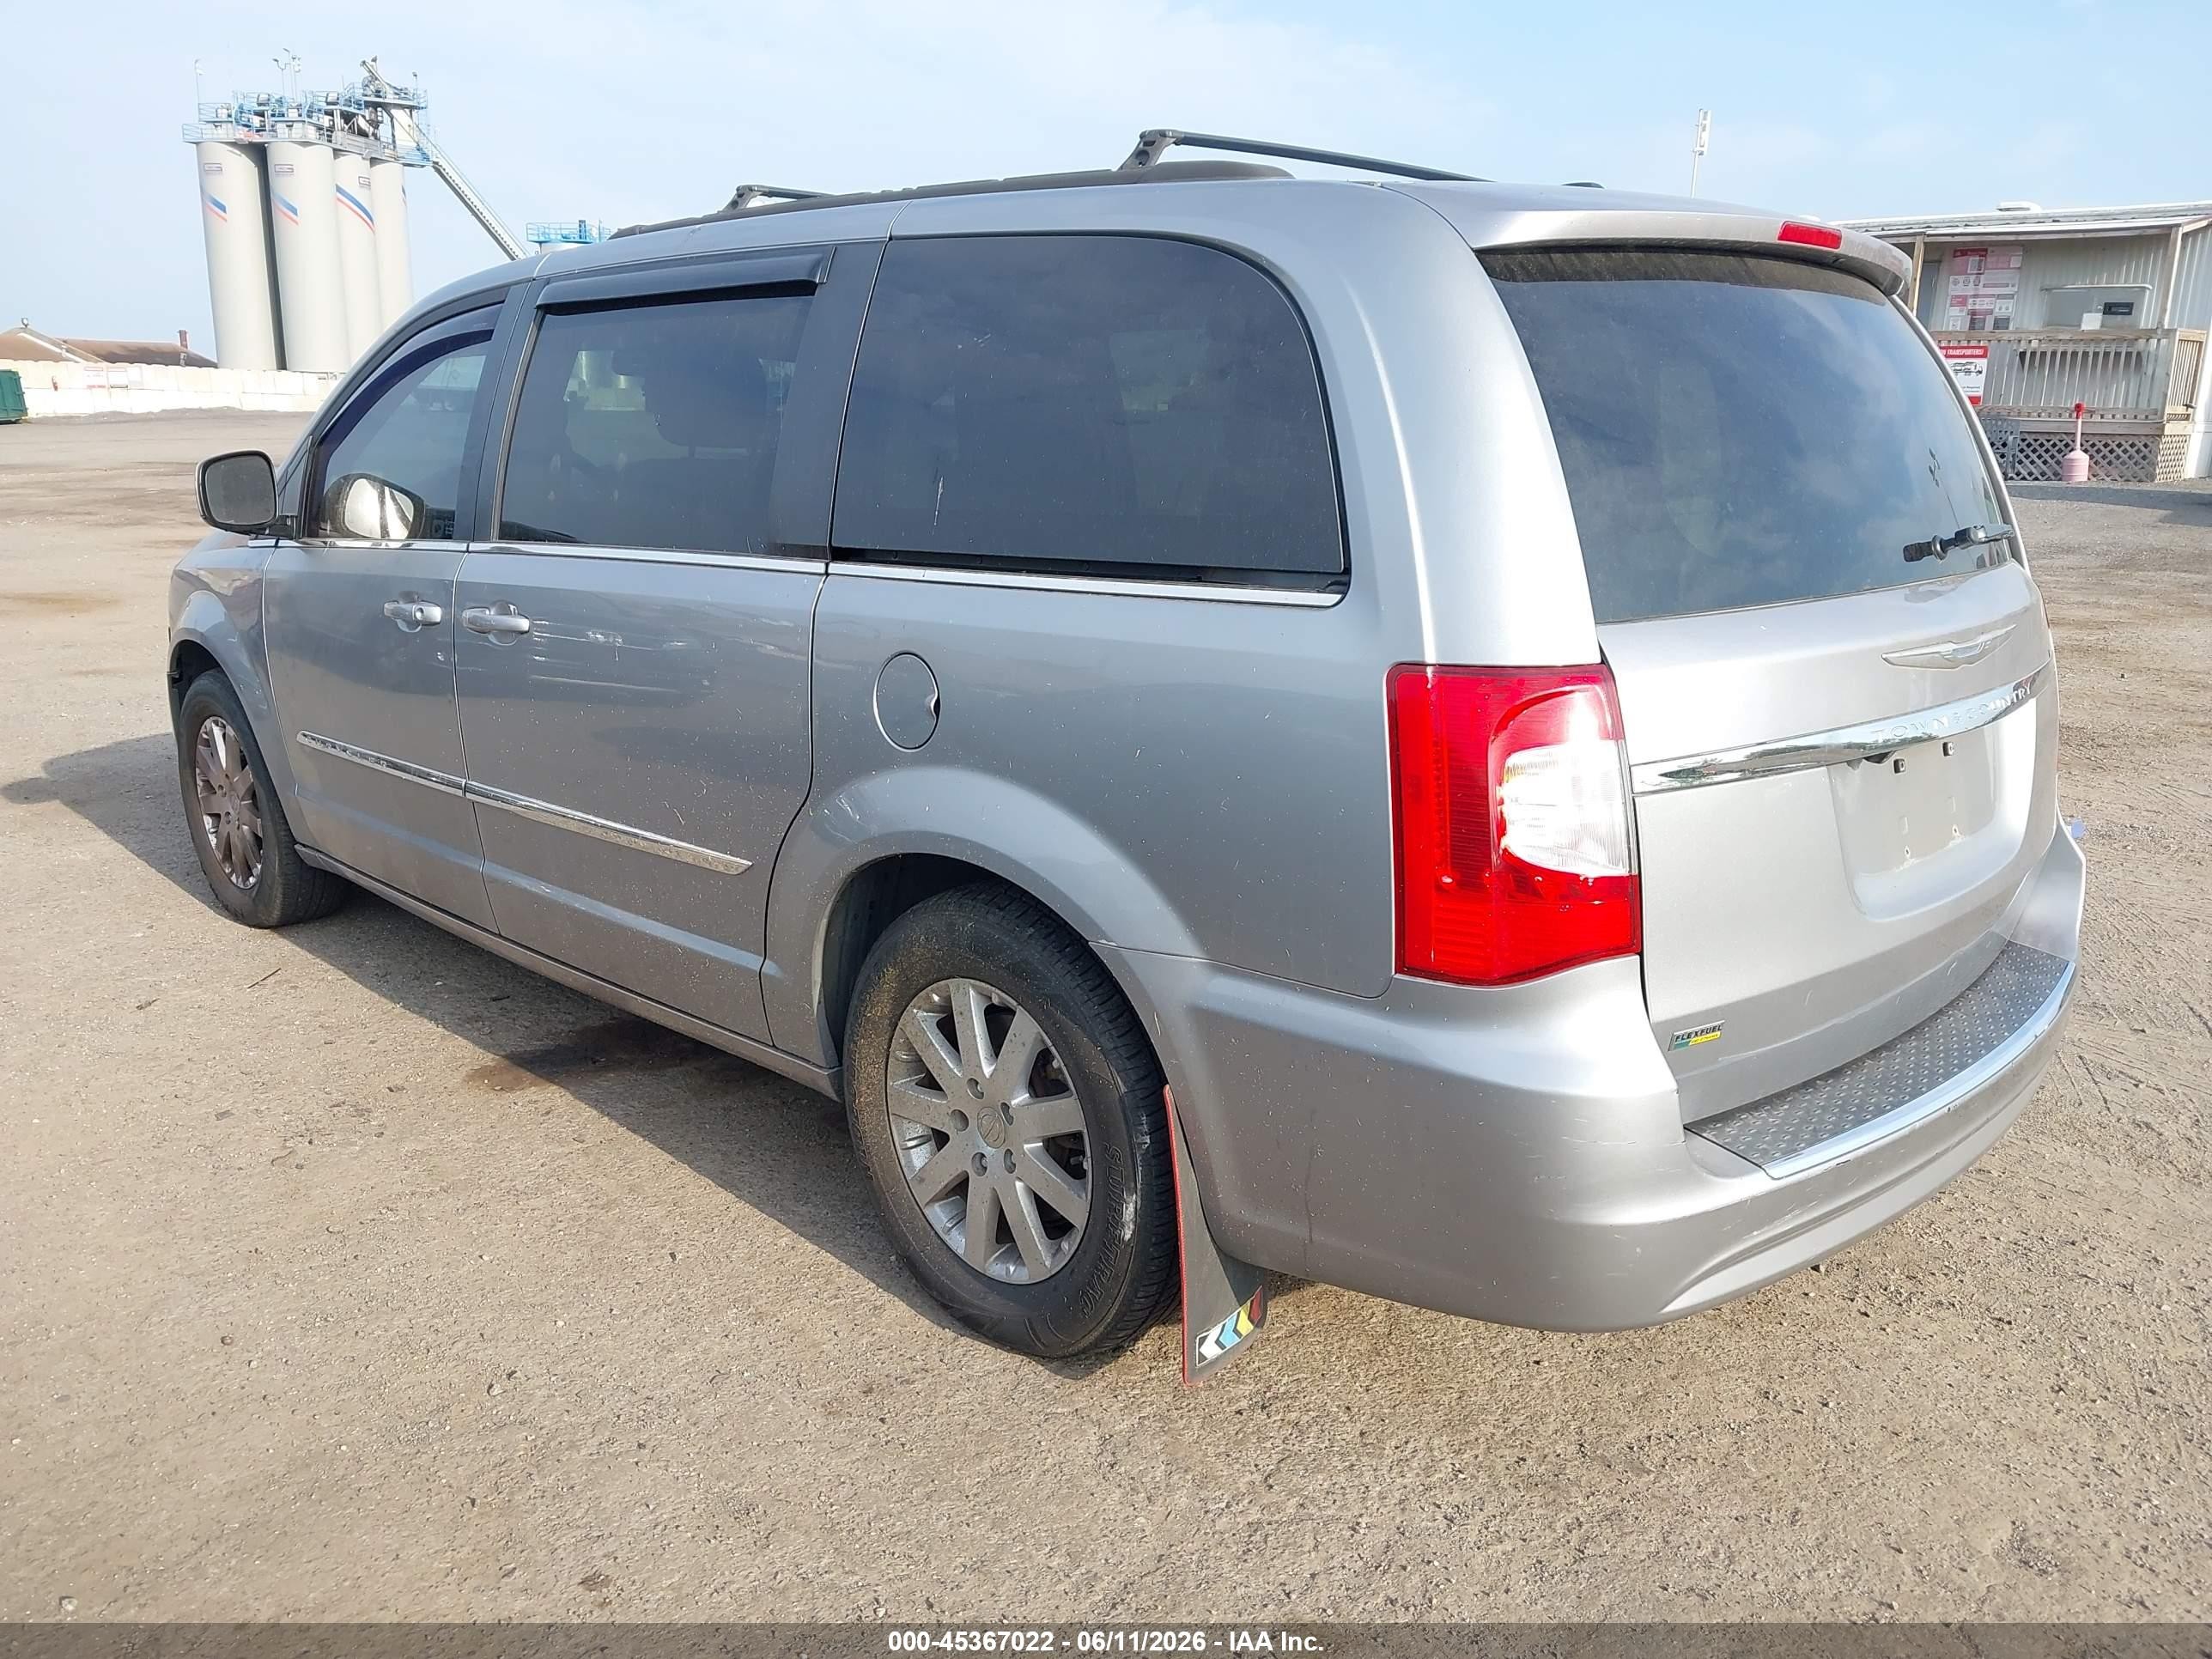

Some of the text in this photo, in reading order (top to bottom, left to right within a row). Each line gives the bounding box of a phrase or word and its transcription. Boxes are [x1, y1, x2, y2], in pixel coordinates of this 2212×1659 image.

[1871, 714, 1949, 744] TOWN
[1966, 681, 2033, 720] COUNTRY
[1674, 1024, 1723, 1042] FLEXFUEL
